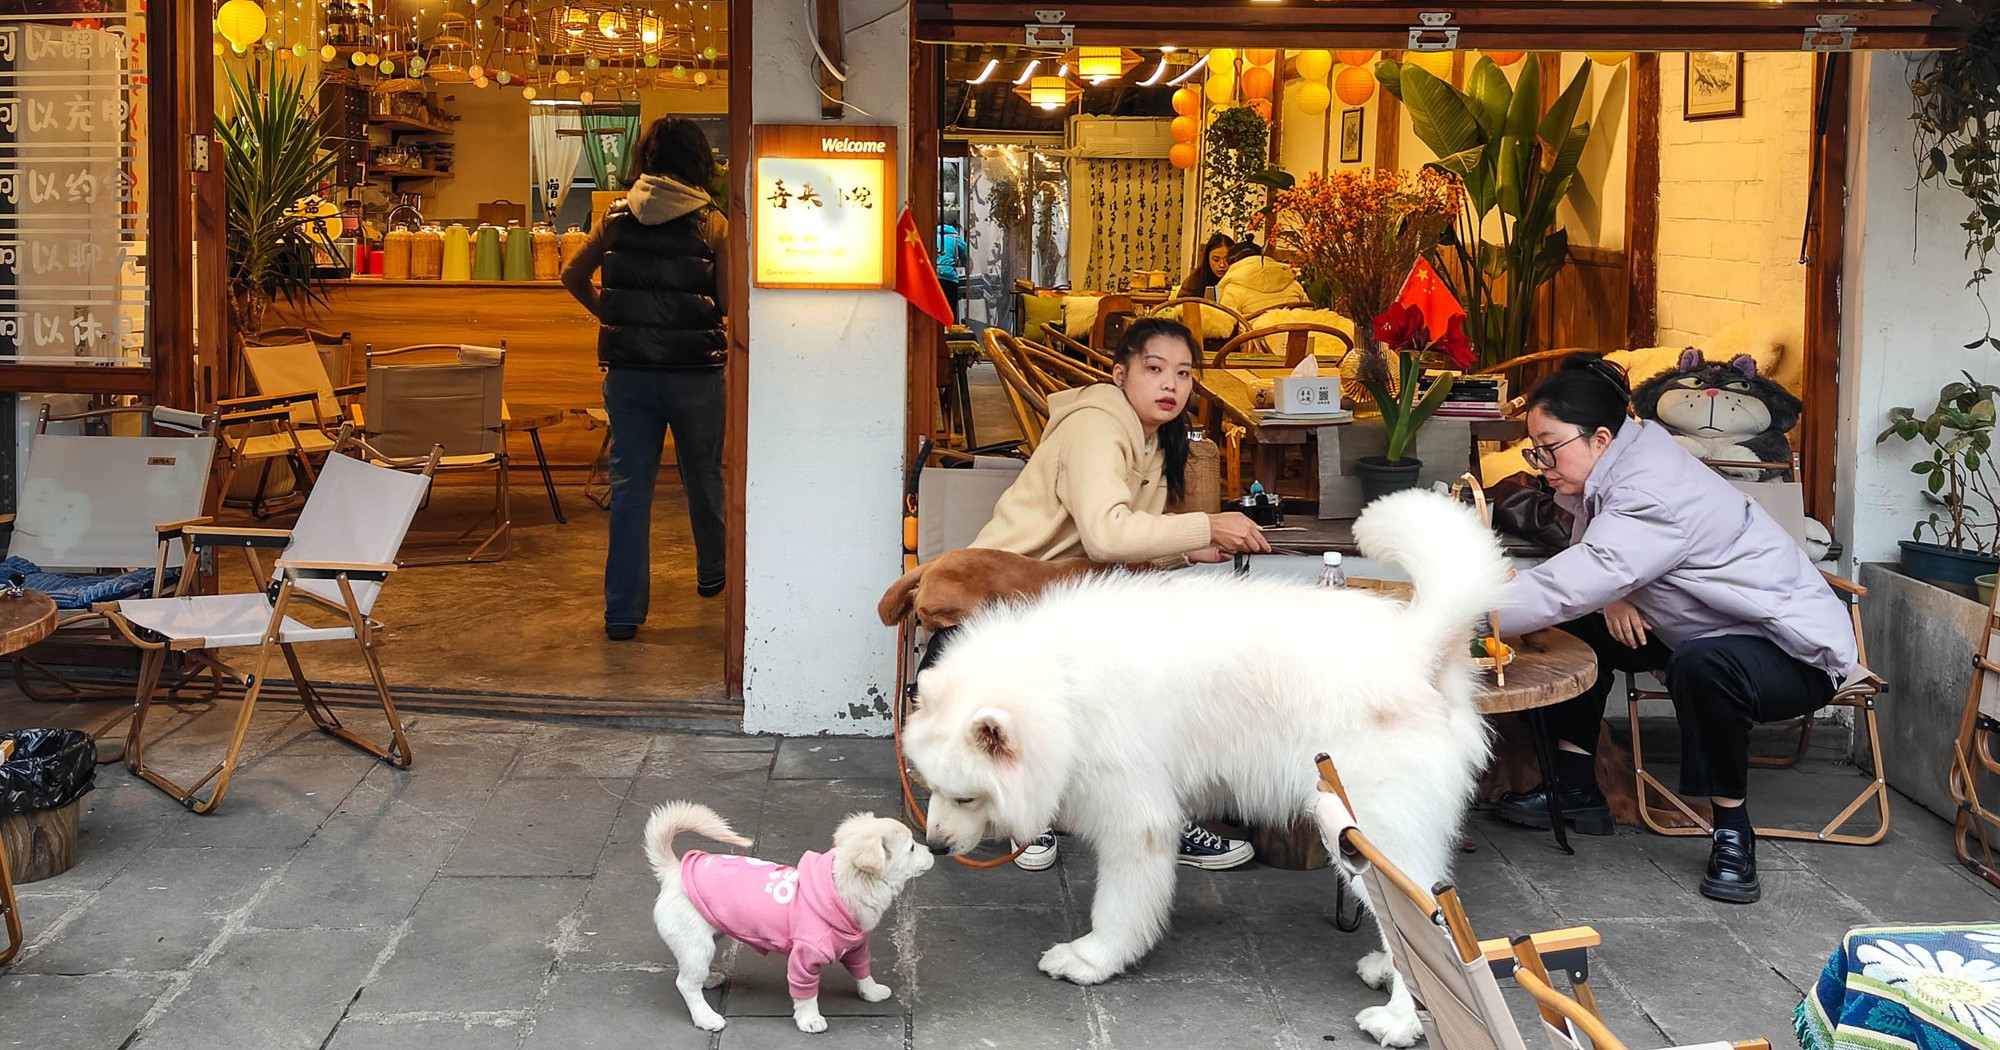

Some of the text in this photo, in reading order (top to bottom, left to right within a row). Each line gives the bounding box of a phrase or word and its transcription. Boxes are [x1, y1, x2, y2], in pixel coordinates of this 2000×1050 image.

[0, 94, 130, 133] 可以充电
[821, 137, 886, 153] Welcome
[0, 168, 135, 204] 可以约会
[0, 239, 139, 276] 可以聊天
